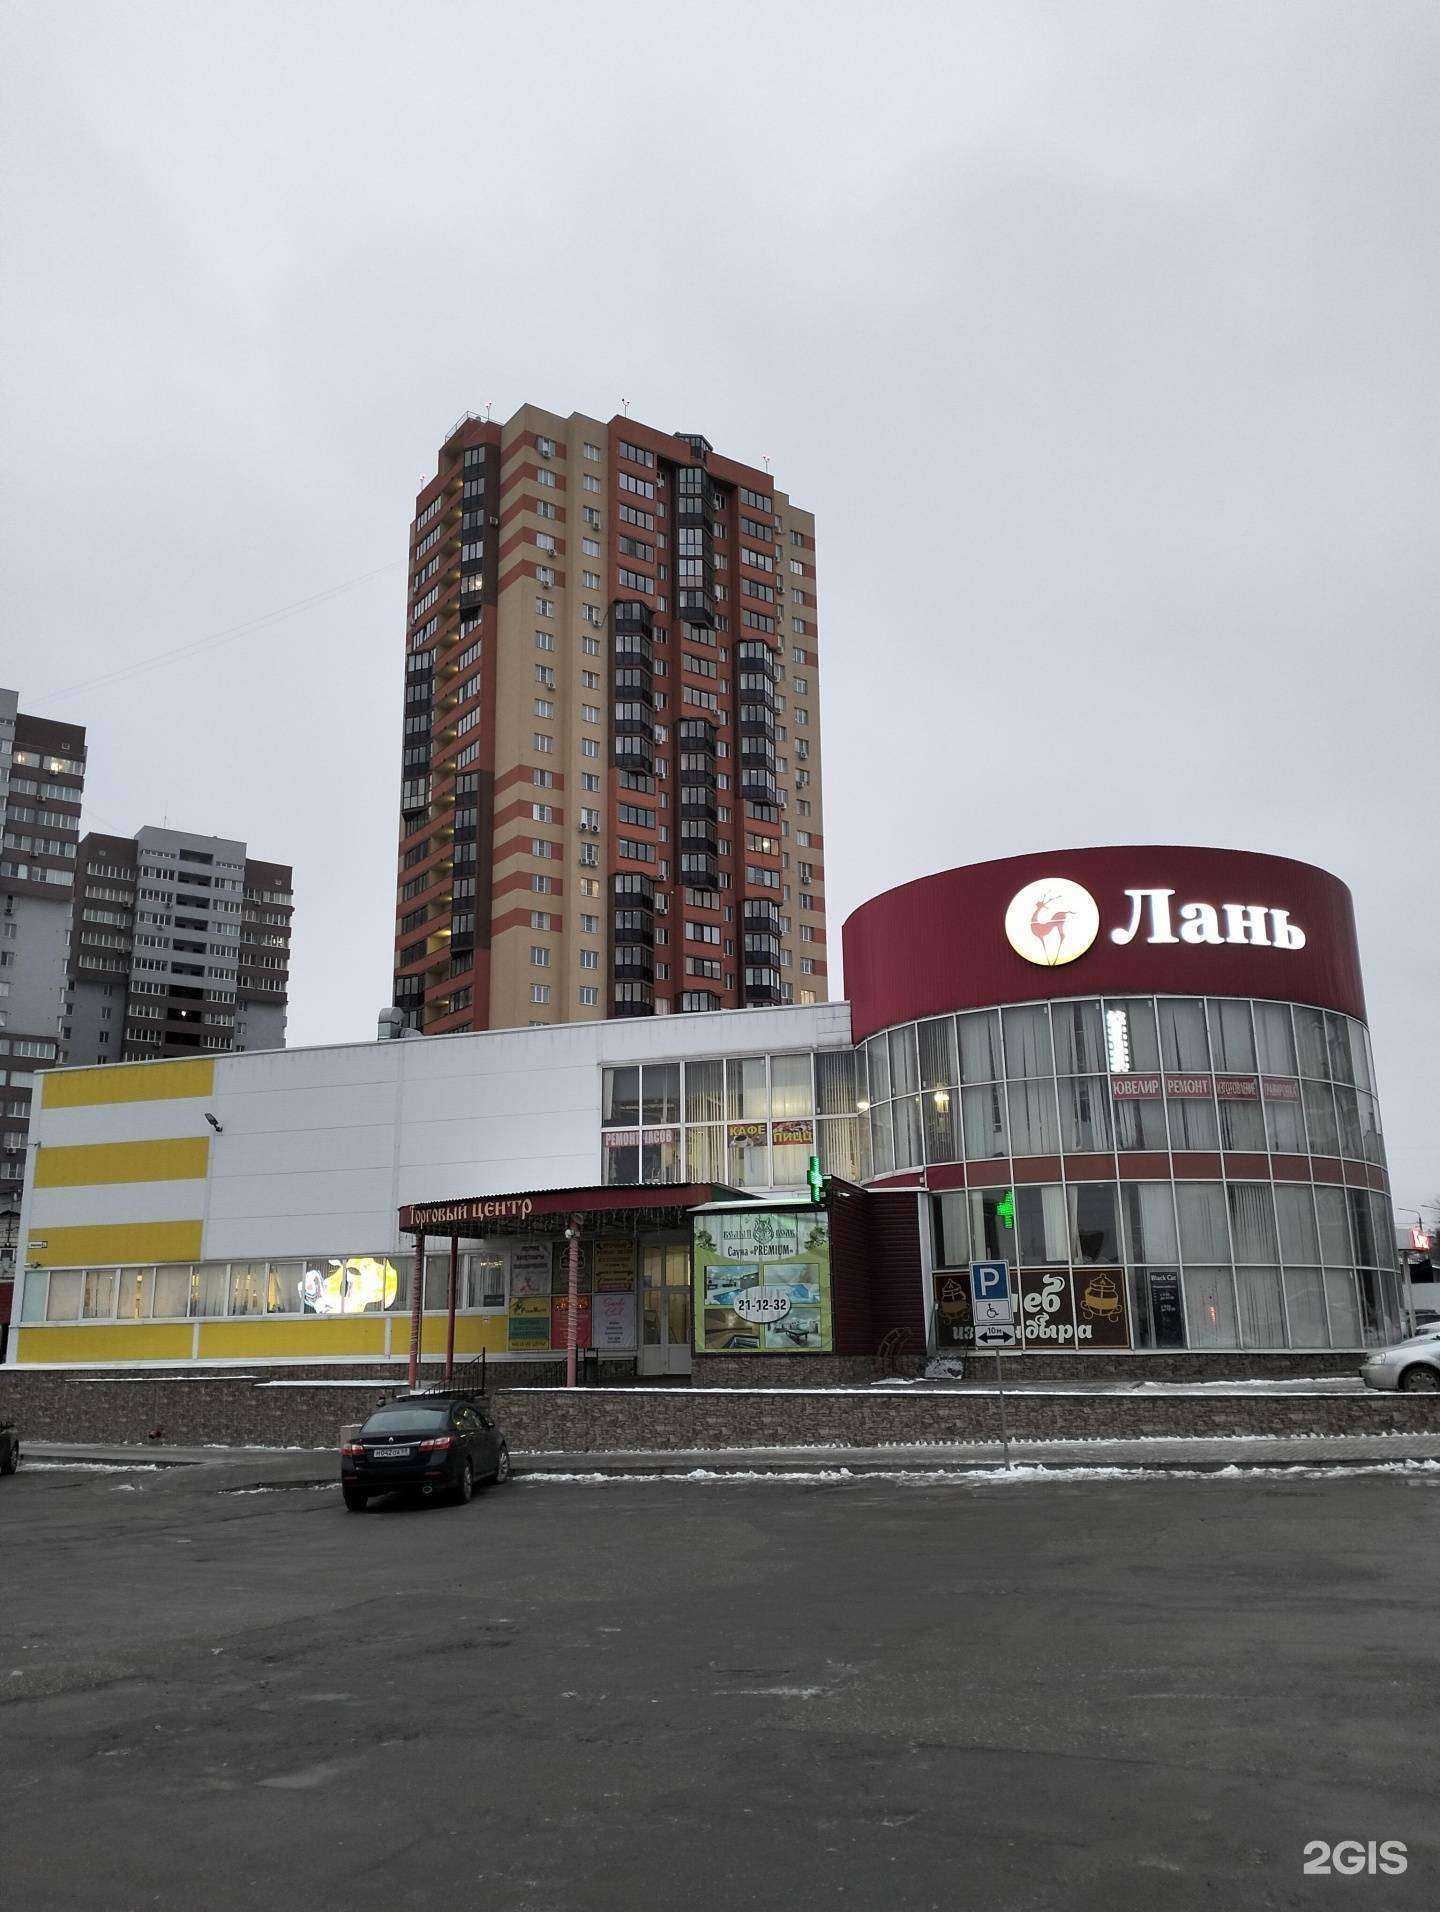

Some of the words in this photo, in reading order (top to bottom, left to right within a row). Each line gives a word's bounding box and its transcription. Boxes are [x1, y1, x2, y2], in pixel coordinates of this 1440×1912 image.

[1111, 887, 1308, 950] Лань
[1113, 1080, 1159, 1095] ЮВЕЛИР
[1167, 1080, 1208, 1094] РЕМОНТ
[729, 1125, 766, 1136] КАФЕ
[605, 1132, 640, 1146] РЕМОНТ
[643, 1130, 672, 1144] ЧАСОВ
[727, 1246, 749, 1258] Сауна
[980, 1268, 1000, 1296] P
[738, 1299, 787, 1311] 21-12-32
